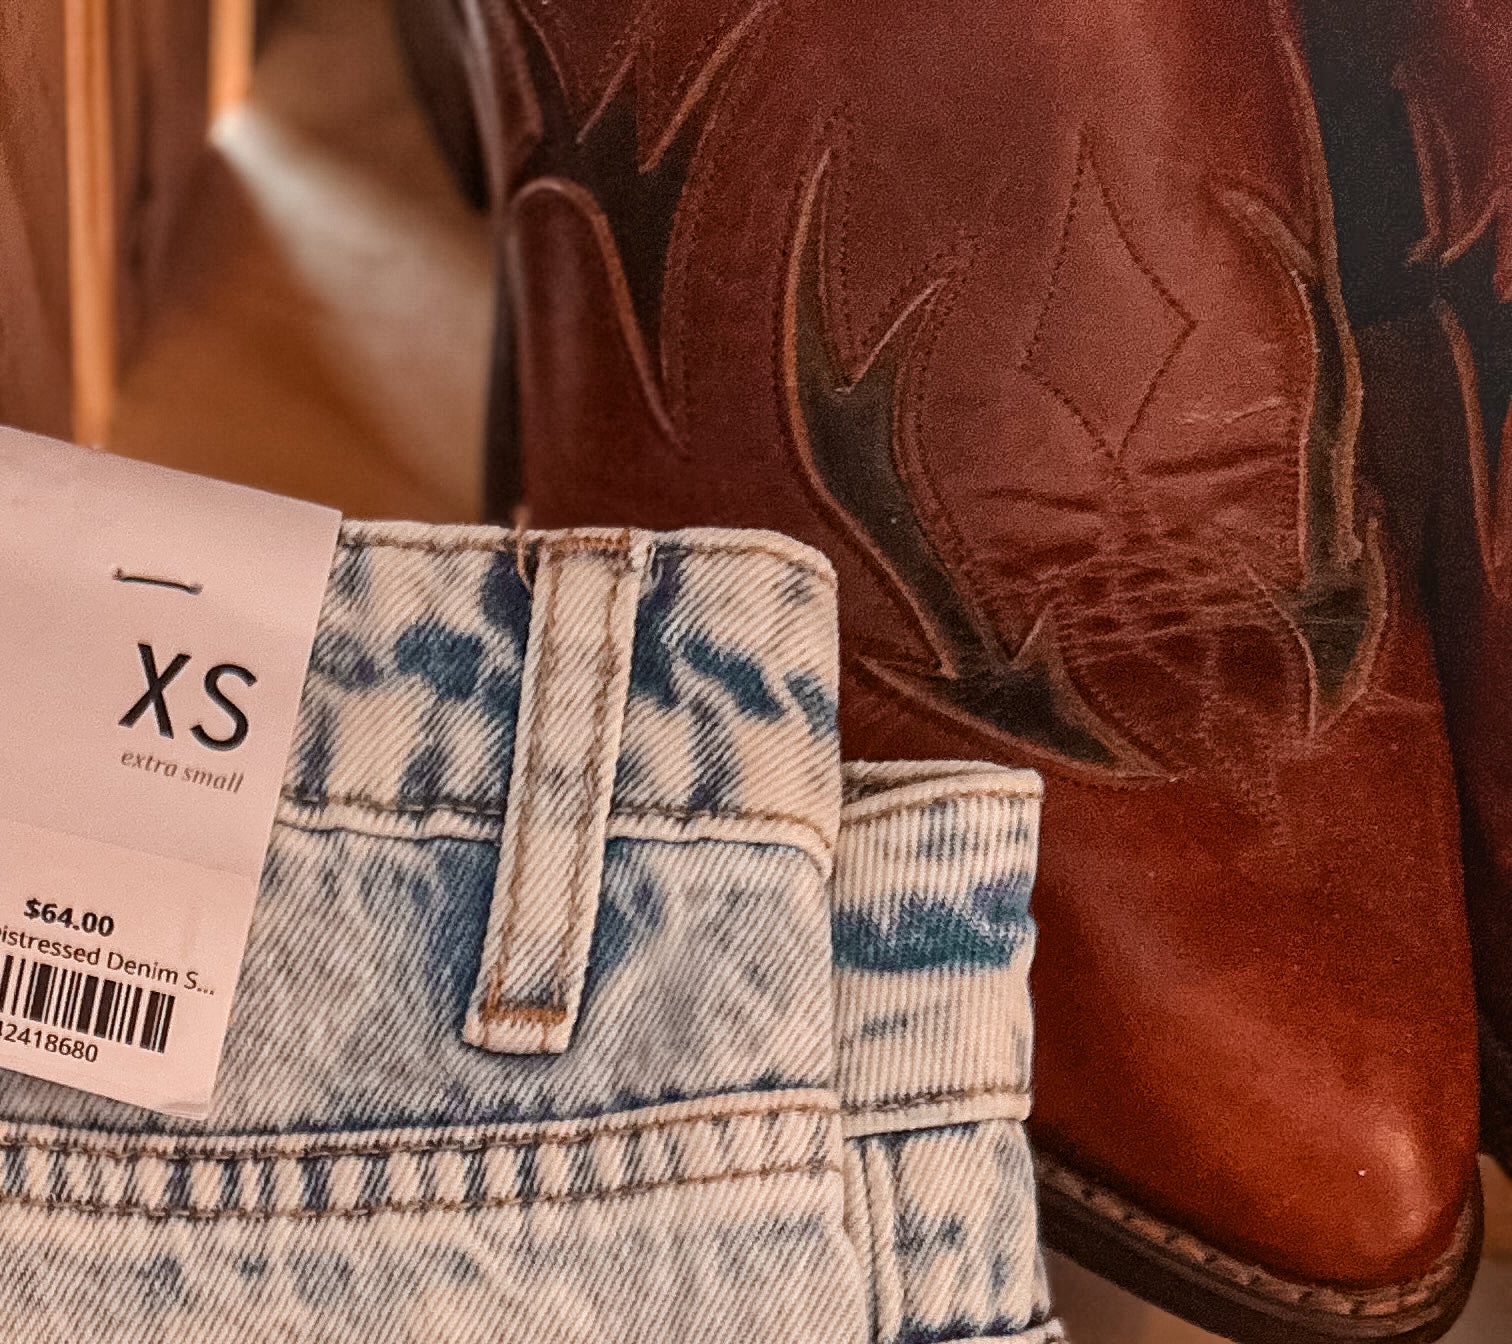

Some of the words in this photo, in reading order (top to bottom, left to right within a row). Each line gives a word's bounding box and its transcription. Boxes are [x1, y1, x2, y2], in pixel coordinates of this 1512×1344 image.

[117, 641, 259, 752] XS
[120, 747, 178, 780] extra
[182, 763, 245, 795] small
[24, 898, 115, 937] $64.00
[107, 951, 179, 985] Denim
